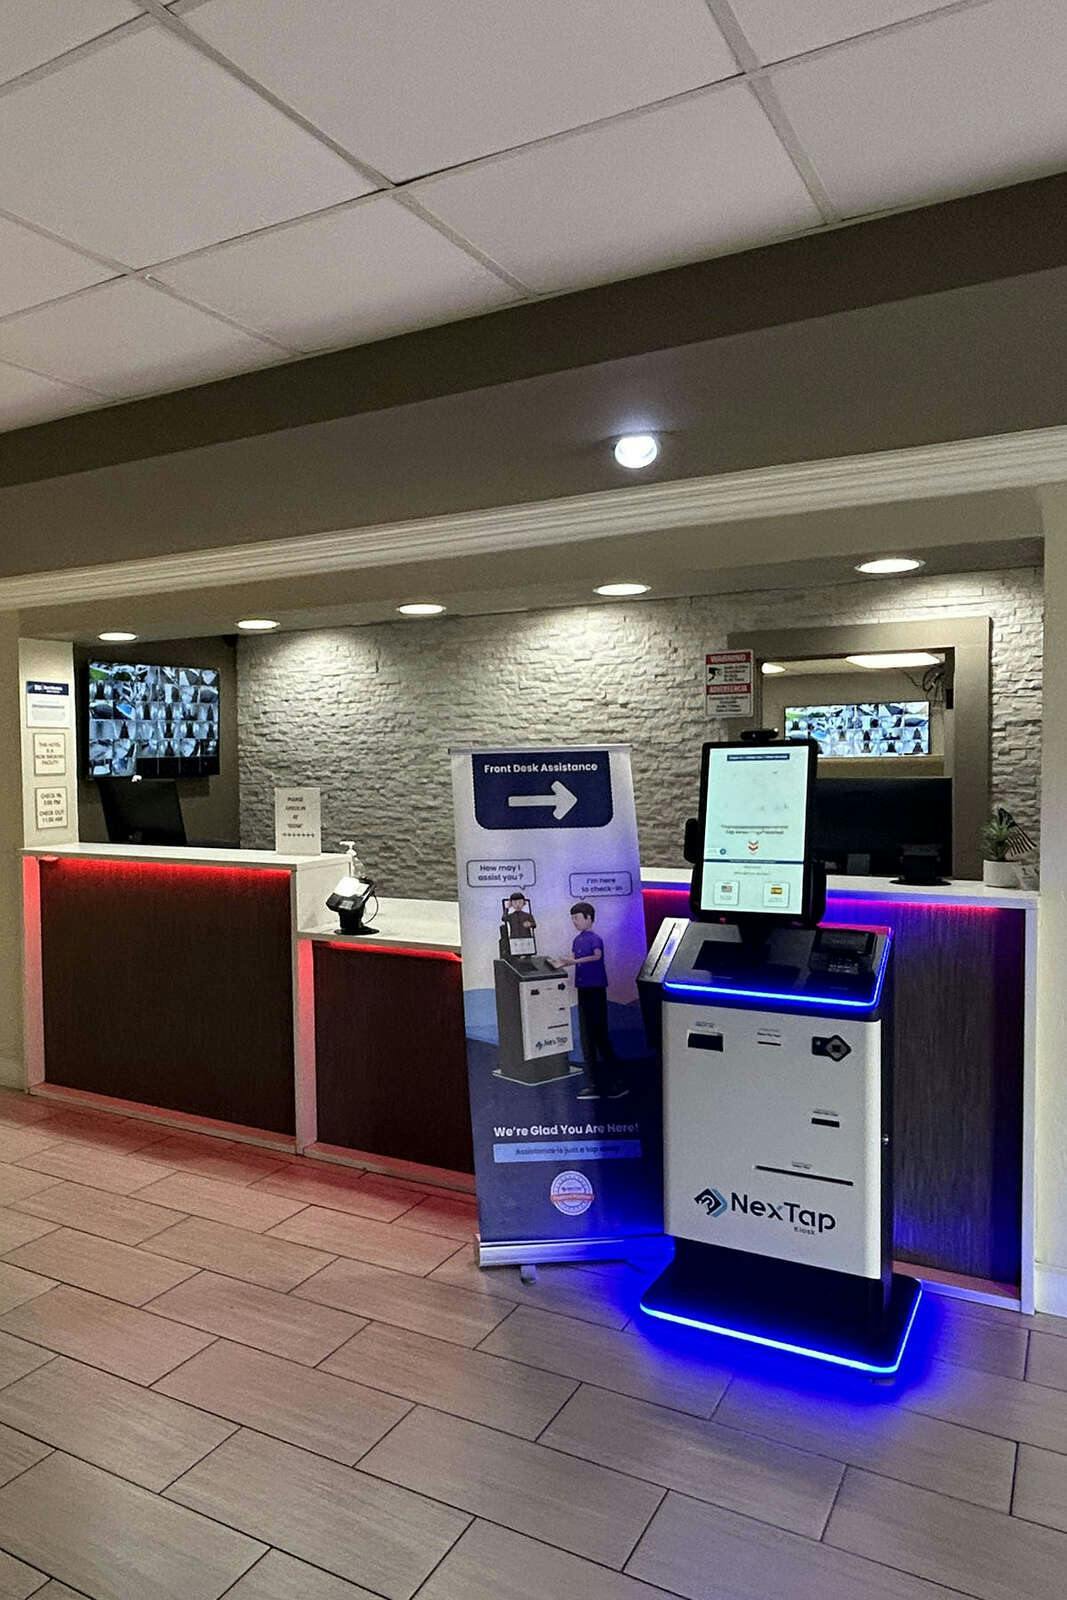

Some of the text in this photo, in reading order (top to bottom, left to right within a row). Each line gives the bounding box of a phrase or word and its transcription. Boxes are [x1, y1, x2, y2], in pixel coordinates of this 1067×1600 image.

[484, 762, 598, 774] Front Desk Assistance
[499, 865, 517, 873] may
[478, 873, 501, 881] assist
[493, 1126, 529, 1138] We're
[531, 1125, 558, 1136] Glad
[560, 1124, 583, 1135] You
[585, 1123, 605, 1134] Are
[731, 1192, 836, 1233] NexTap
[793, 1226, 816, 1235] Kiosk
